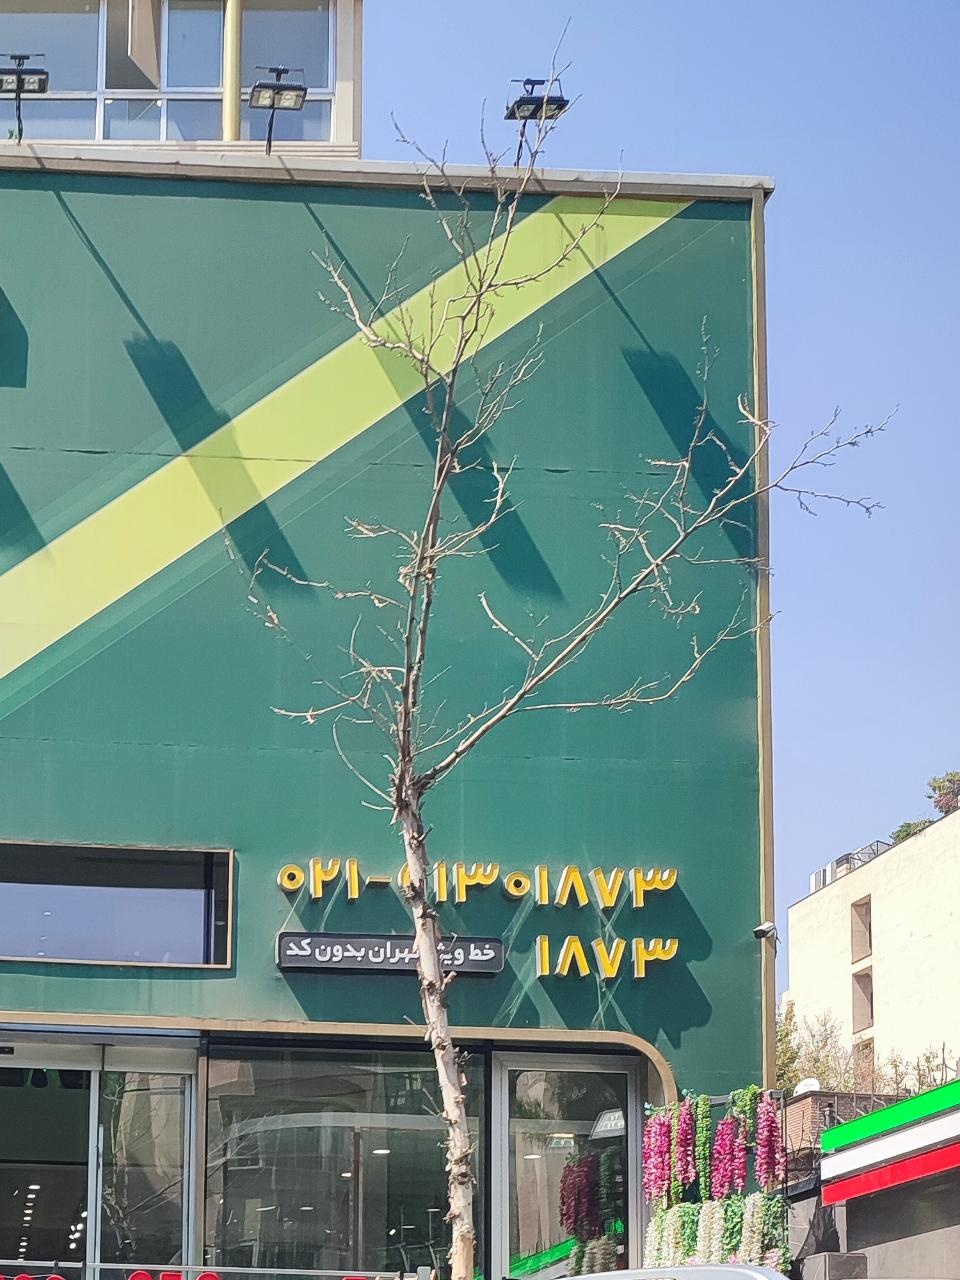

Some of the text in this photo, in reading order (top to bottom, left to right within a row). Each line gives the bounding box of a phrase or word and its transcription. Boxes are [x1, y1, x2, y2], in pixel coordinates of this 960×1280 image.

[286, 938, 311, 956] کد
[314, 942, 365, 962] بدون
[468, 943, 496, 961] خط
[535, 934, 679, 980] ۱۸۷۳
